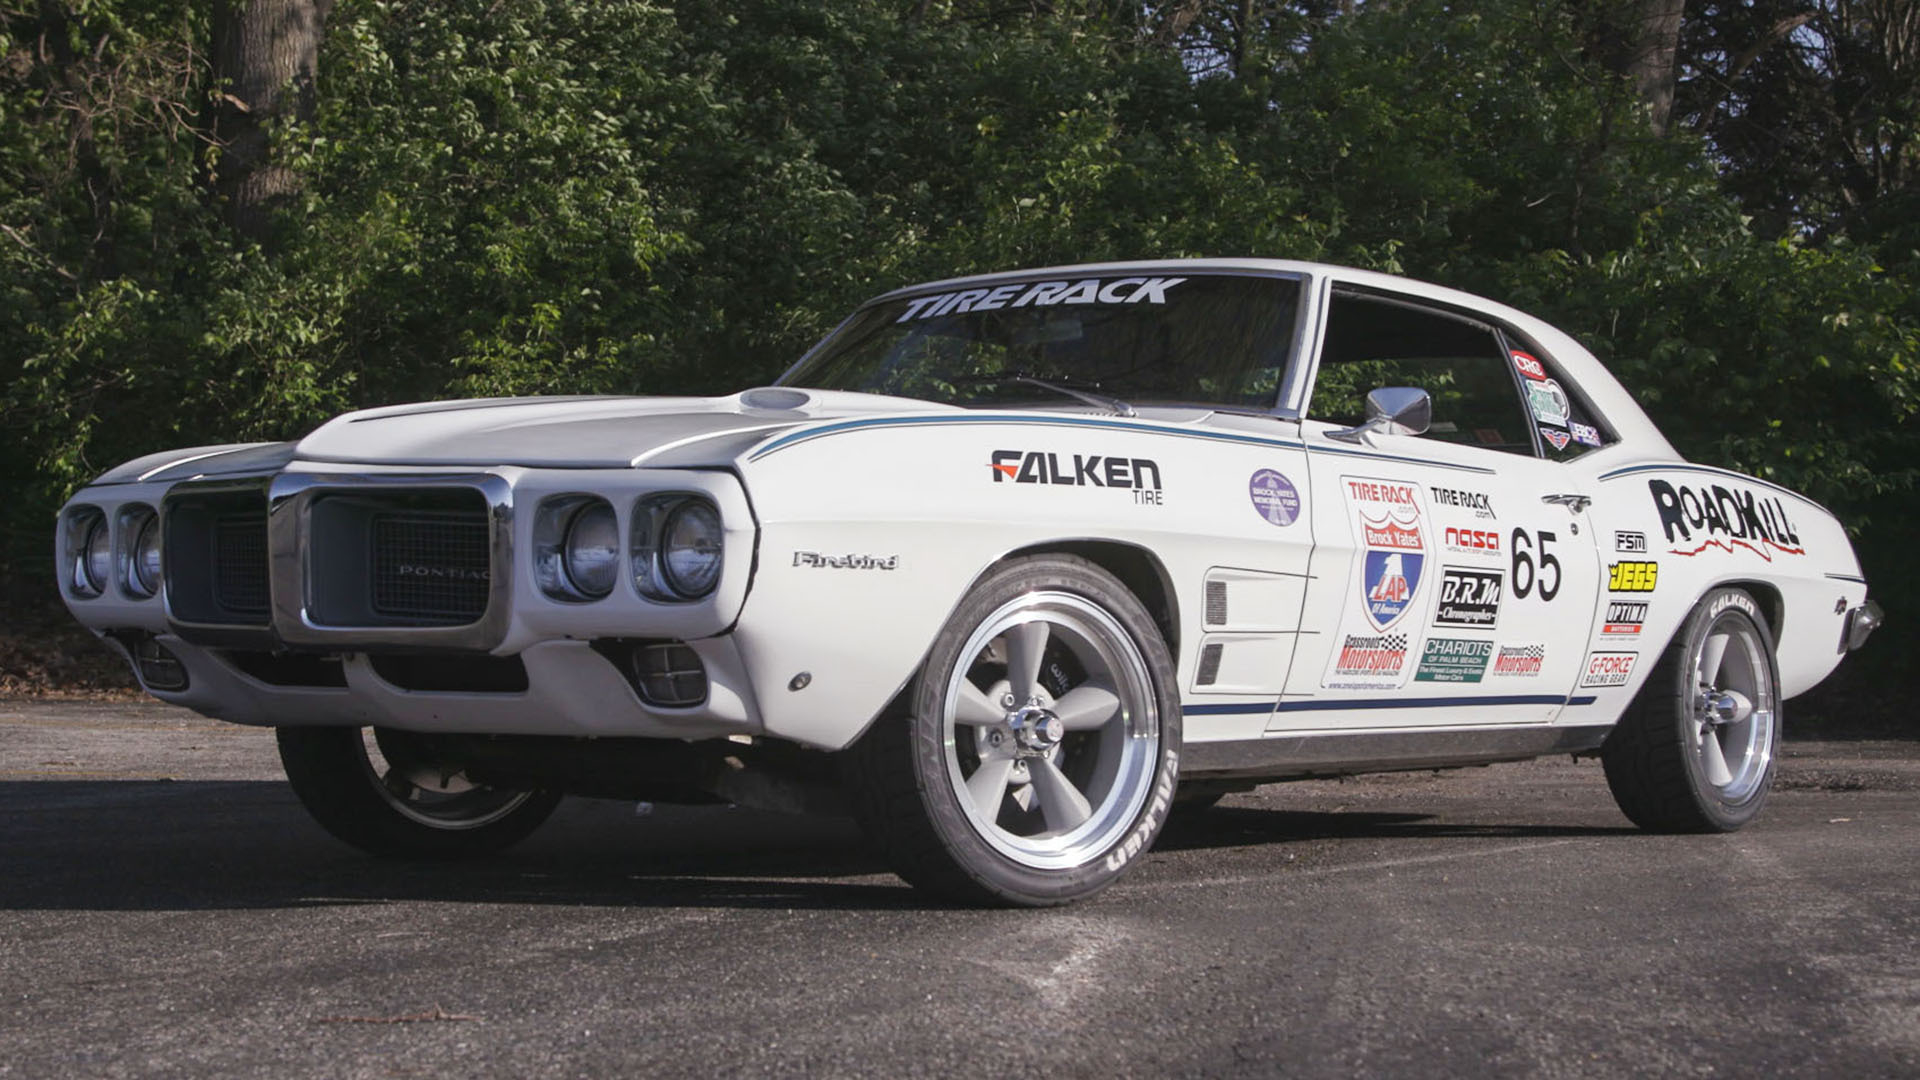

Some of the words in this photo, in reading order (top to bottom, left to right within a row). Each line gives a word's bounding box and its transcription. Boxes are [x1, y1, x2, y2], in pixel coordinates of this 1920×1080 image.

[896, 284, 1027, 323] TIRE
[1011, 278, 1187, 308] RACK
[989, 450, 1162, 490] FALKEN
[1132, 490, 1163, 505] TIRE
[1348, 481, 1379, 501] TIRE
[1380, 484, 1420, 514] RACK
[1430, 487, 1459, 505] TIRE
[1459, 491, 1496, 519] RACK
[1648, 479, 1800, 546] ROADKILL
[1367, 530, 1393, 545] Brock
[400, 565, 491, 579] PONTIAC
[792, 551, 899, 570] Firebird
[1511, 527, 1562, 602] 65
[1608, 561, 1658, 592] JEGS
[1373, 576, 1407, 601] LAP
[1442, 576, 1500, 605] B.R.M
[1607, 604, 1648, 622] OPTIMA
[1710, 593, 1755, 619] FALKEN
[1345, 634, 1381, 649] Grassroots
[1425, 640, 1493, 656] CHARIOTS
[1337, 646, 1406, 675] Motorsports
[1428, 655, 1438, 663] OF
[1430, 666, 1446, 674] Finest
[1446, 667, 1463, 675] Luxury
[1494, 653, 1544, 674] Motorsports
[1590, 656, 1635, 674] G-FORCE
[1585, 674, 1609, 684] RACING
[1609, 673, 1627, 684] GEAR
[1106, 749, 1179, 871] FALKEN
